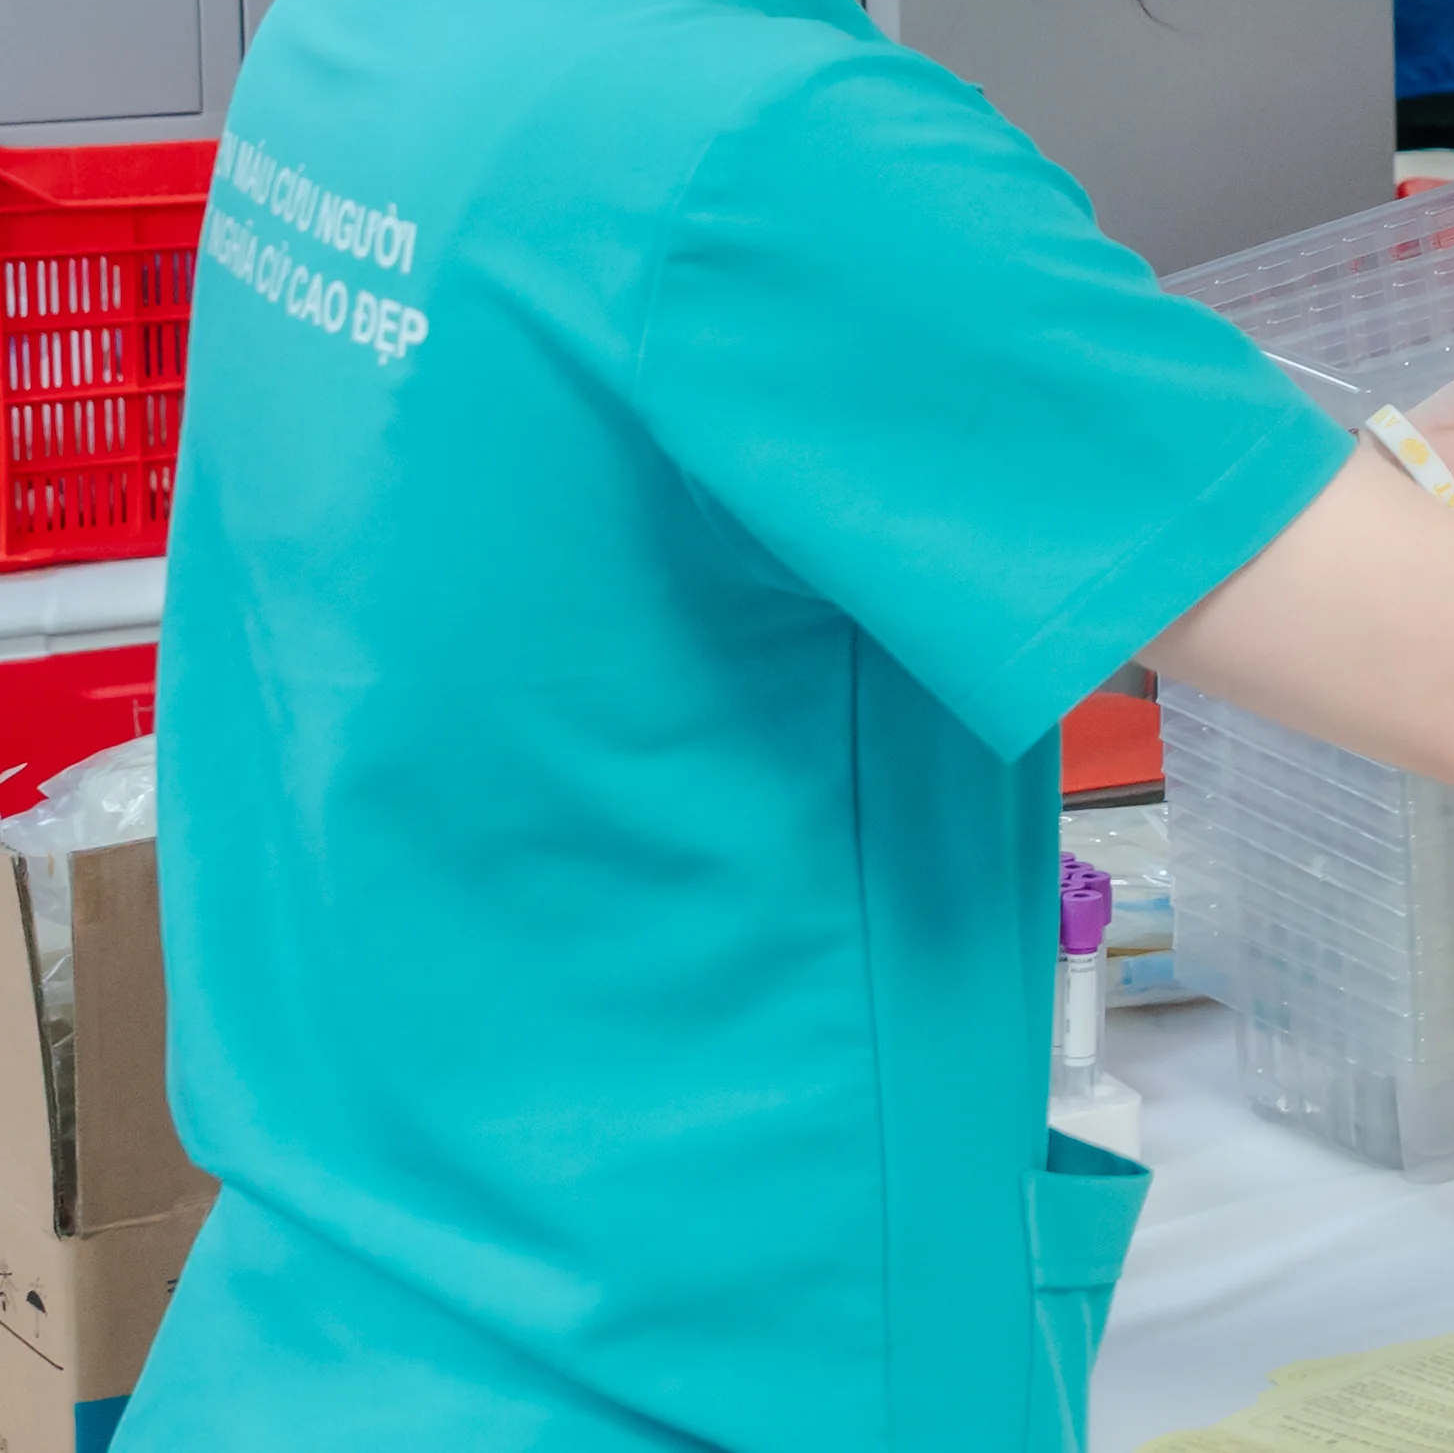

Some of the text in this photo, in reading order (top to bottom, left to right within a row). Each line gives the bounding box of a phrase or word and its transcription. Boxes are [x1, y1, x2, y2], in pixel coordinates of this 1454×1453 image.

[313, 190, 417, 275] NGƯỜI
[286, 264, 349, 334] CAO
[351, 289, 430, 367] ĐẸP
